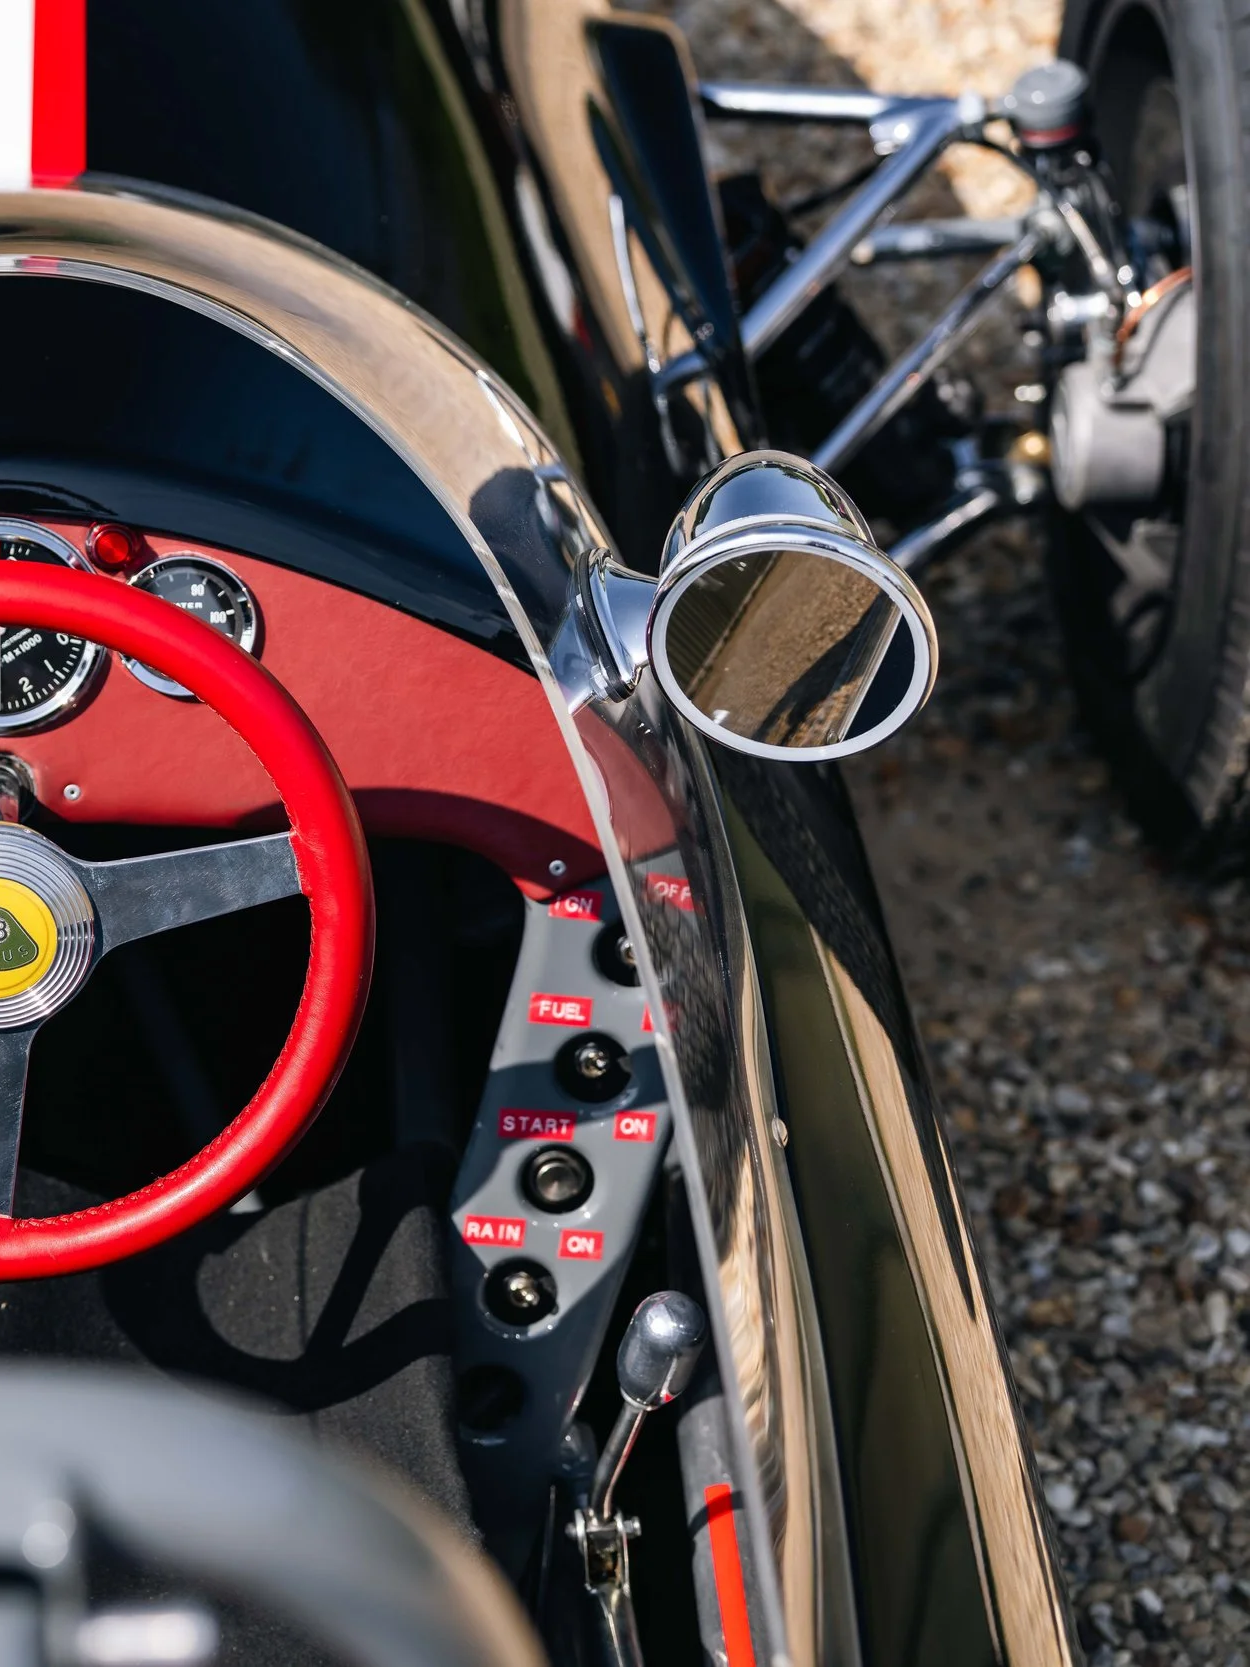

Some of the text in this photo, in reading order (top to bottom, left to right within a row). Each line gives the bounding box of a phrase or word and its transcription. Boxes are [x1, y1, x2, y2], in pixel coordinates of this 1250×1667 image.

[190, 584, 205, 596] 90
[175, 601, 203, 610] TER
[209, 610, 227, 624] 100
[43, 659, 55, 673] 1
[18, 676, 34, 693] 2
[653, 880, 692, 902] OFF
[553, 894, 594, 914] IGN
[538, 999, 586, 1022] FUEL
[502, 1115, 572, 1136] START
[620, 1117, 649, 1136] ON
[466, 1222, 521, 1242] RAIN
[566, 1235, 596, 1254] ON
